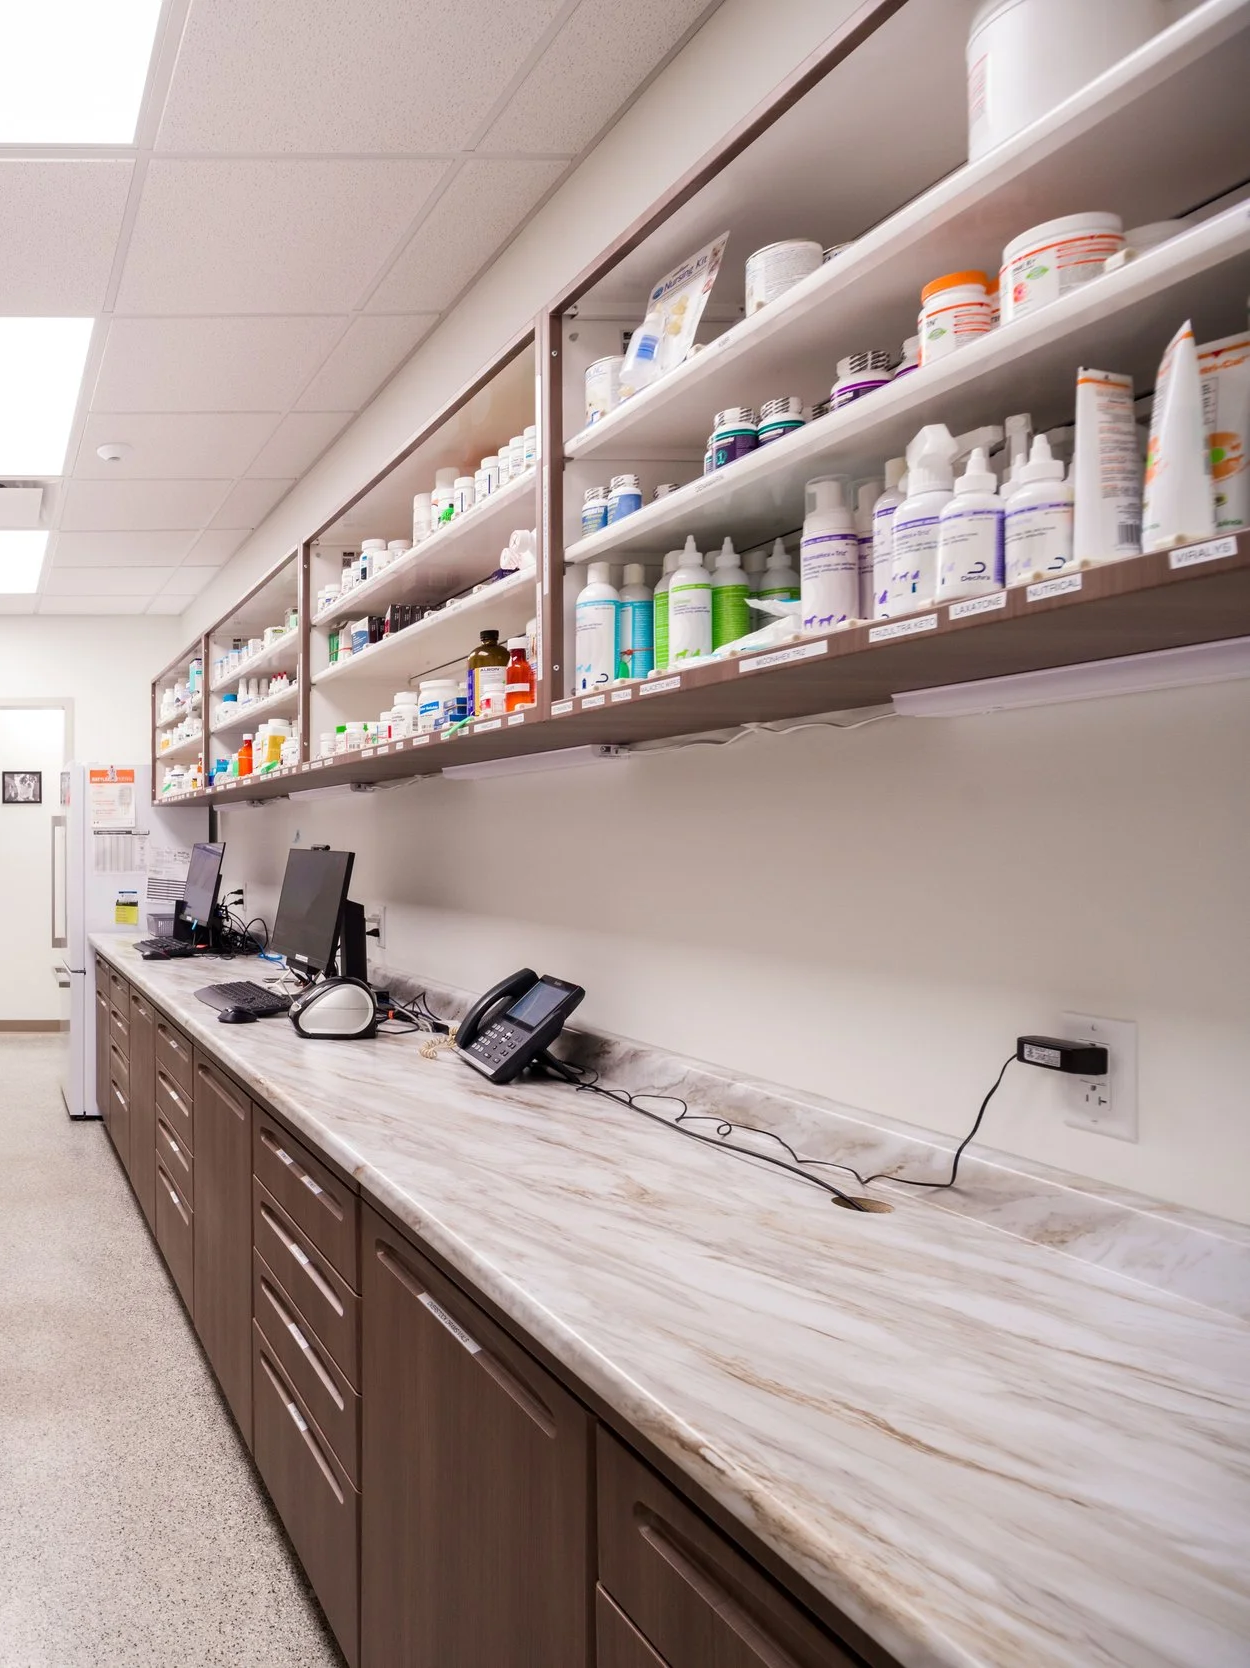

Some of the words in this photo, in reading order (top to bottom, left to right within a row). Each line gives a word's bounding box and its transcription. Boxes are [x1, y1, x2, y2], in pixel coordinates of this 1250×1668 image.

[663, 265, 695, 293] Nursing
[695, 255, 708, 270] Kit
[1174, 541, 1232, 564] VIRALYS
[960, 574, 991, 582] Dechra
[1028, 578, 1080, 599] NUTRICAL
[953, 595, 1003, 617] LAXATONE
[871, 621, 912, 640] TRIZULTRA
[913, 616, 936, 629] KETO
[755, 653, 791, 667] MICONAHEX
[792, 648, 807, 658] TRIZ
[665, 678, 680, 688] WIPES
